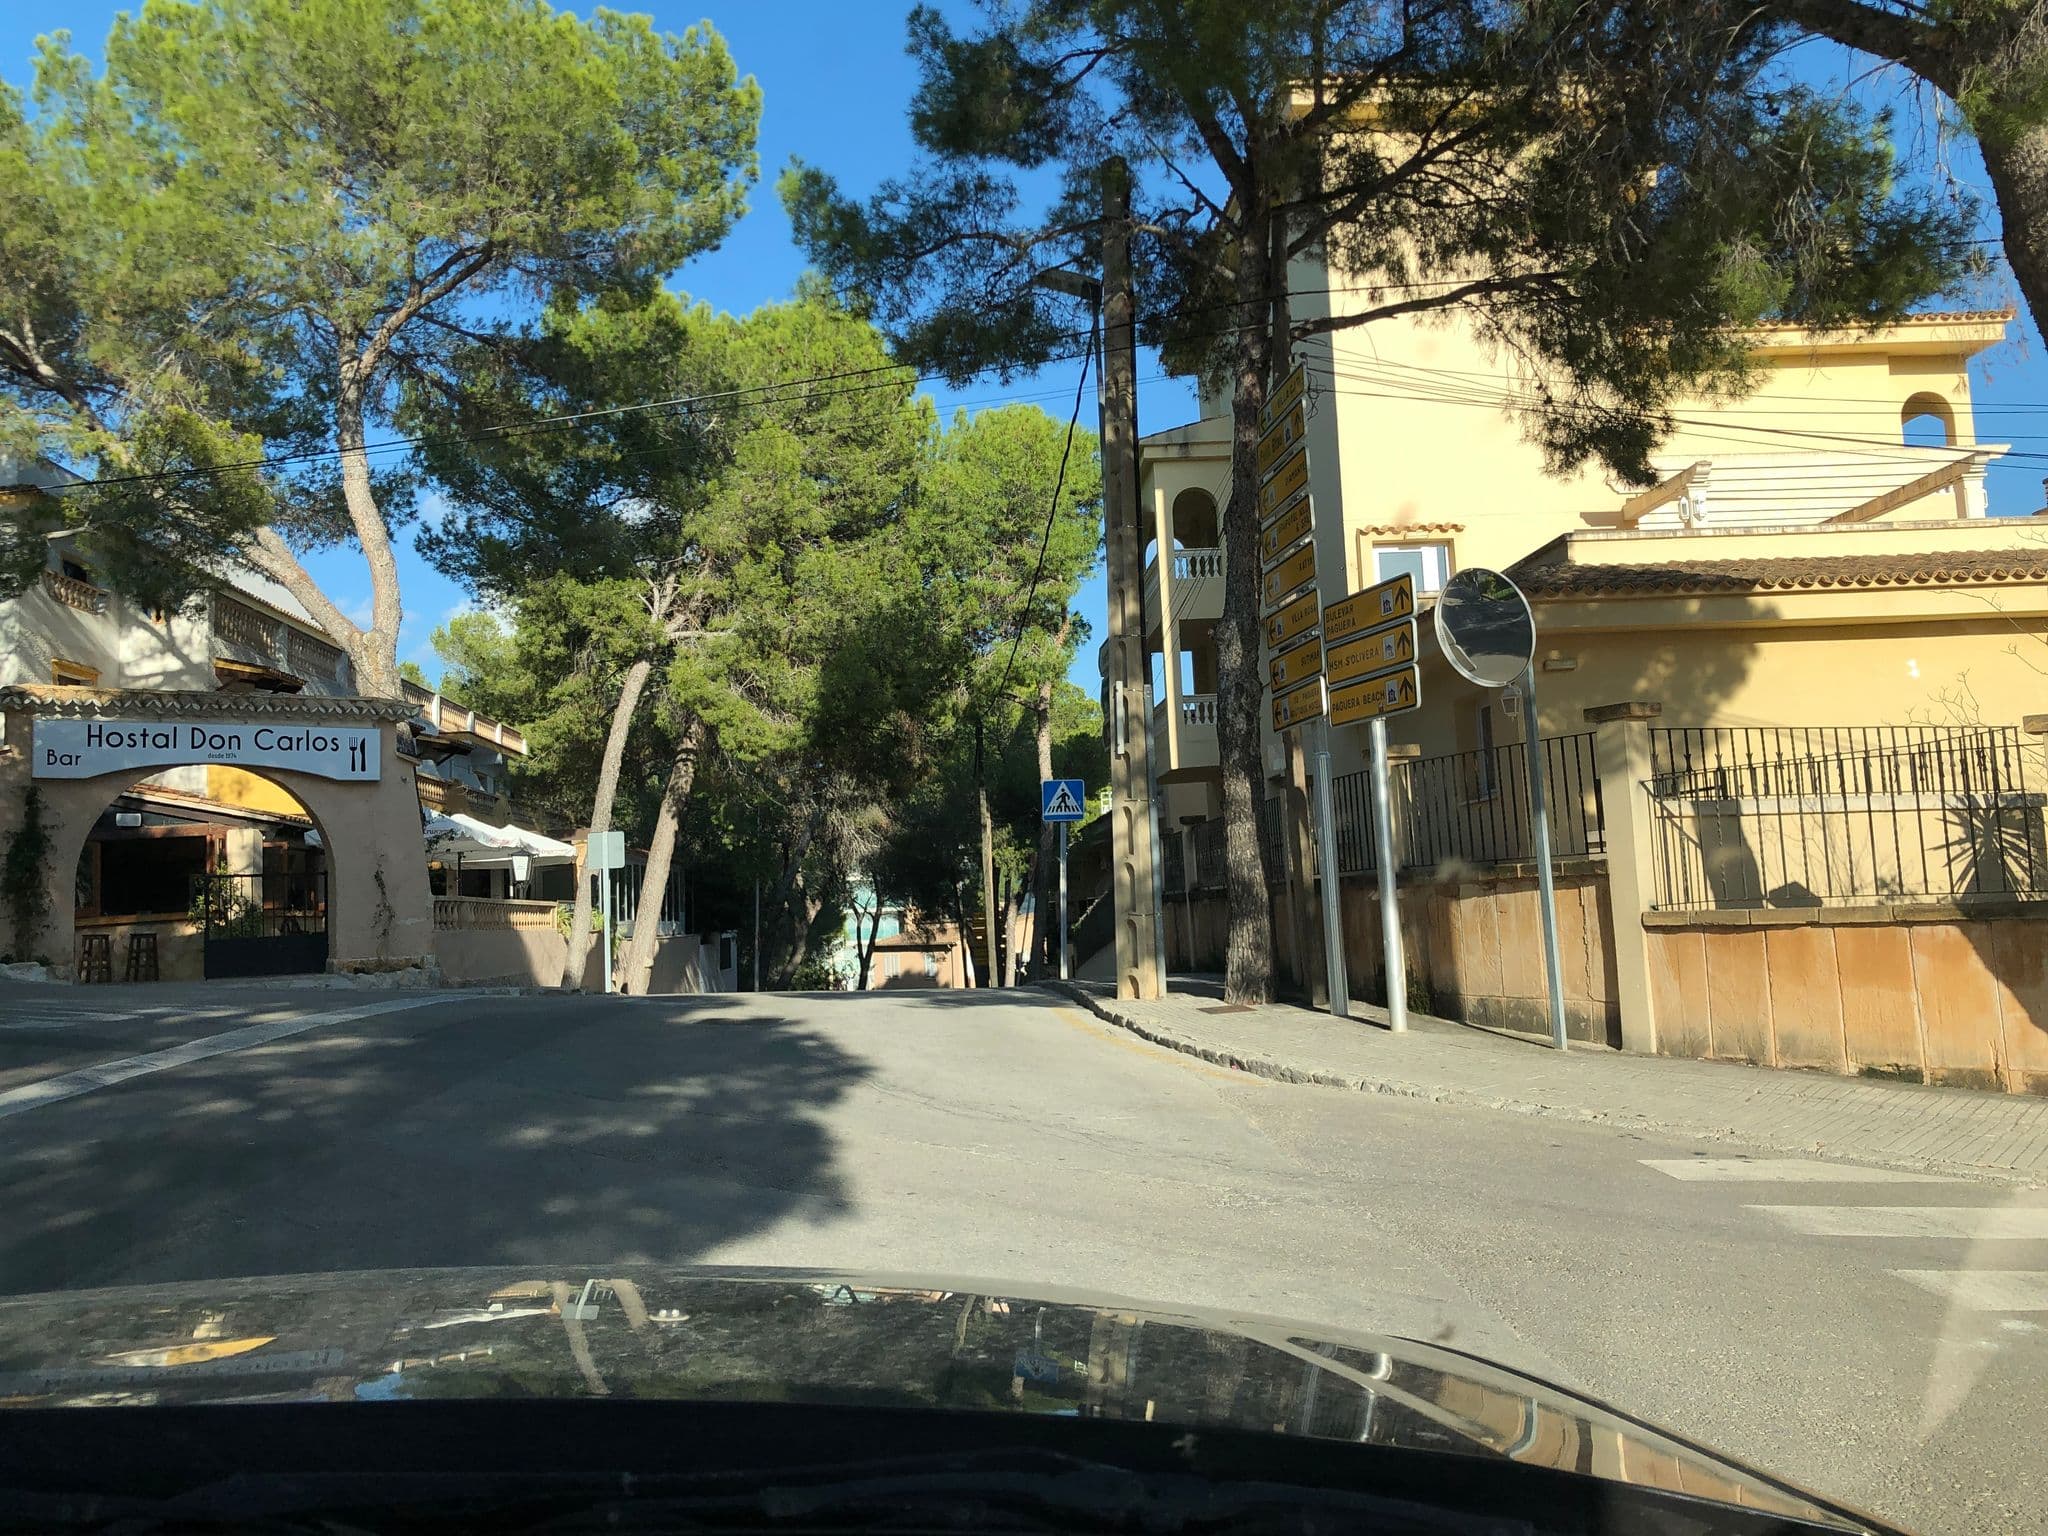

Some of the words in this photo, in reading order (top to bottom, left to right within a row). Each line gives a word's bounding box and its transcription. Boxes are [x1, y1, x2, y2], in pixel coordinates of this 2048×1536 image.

[1325, 604, 1354, 623] BULEVAR
[1326, 619, 1357, 635] PAGUERA
[1329, 660, 1343, 672] HSM
[1332, 697, 1360, 713] PAGUERA
[1363, 689, 1386, 705] BEACH
[86, 724, 177, 749] Hostal
[191, 727, 241, 750] Don
[254, 729, 340, 752] Carlos
[46, 750, 82, 766] Bar
